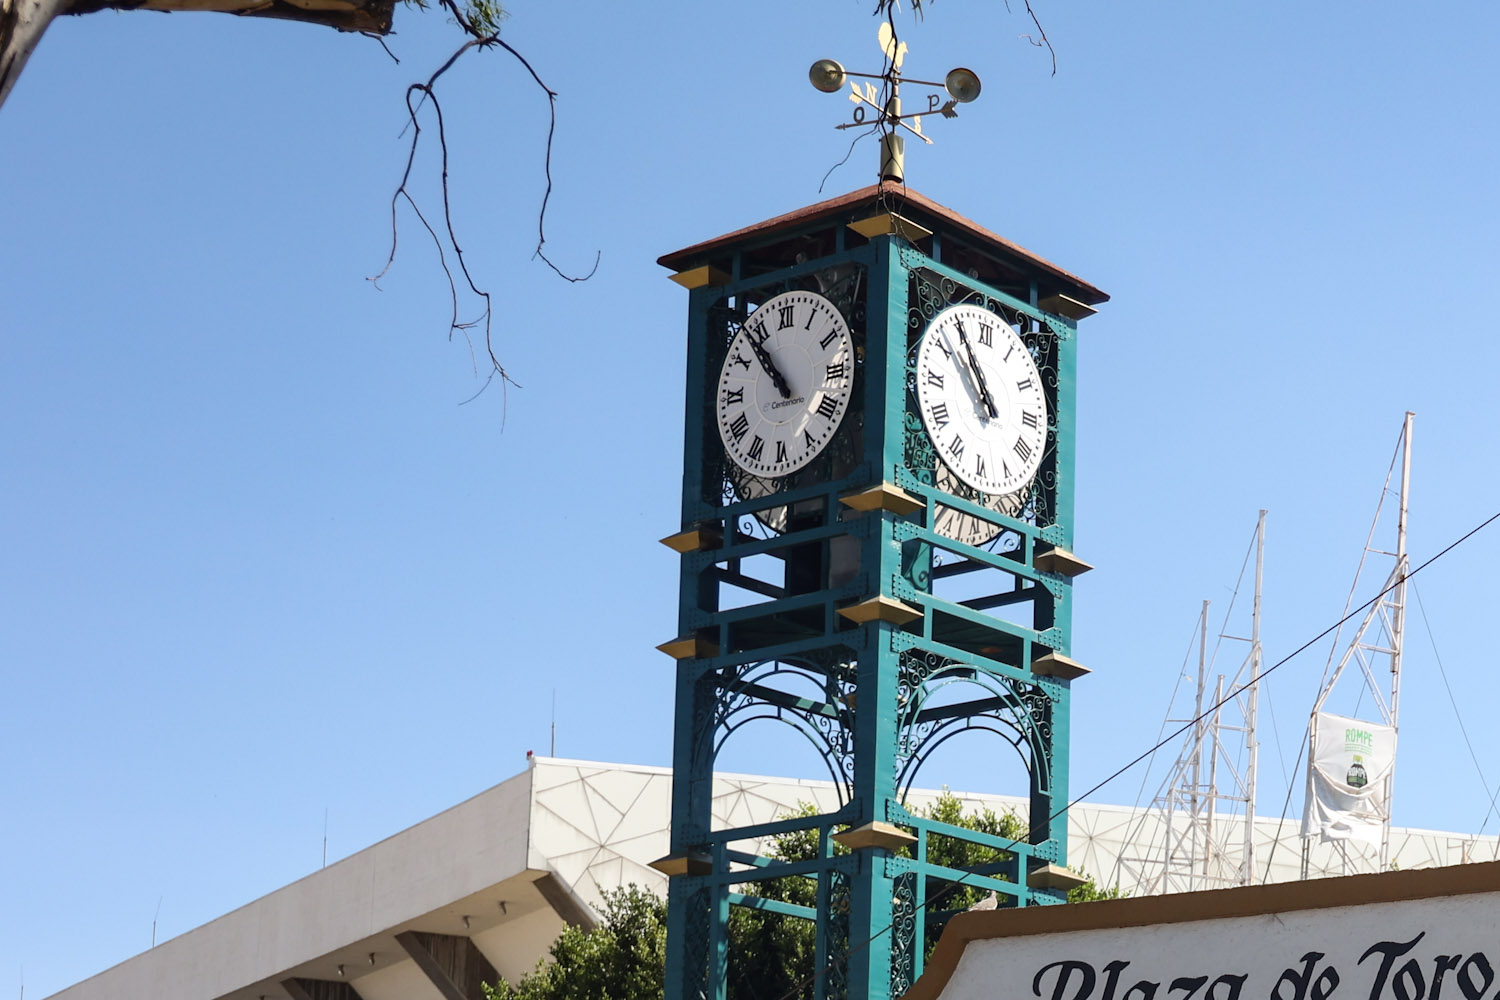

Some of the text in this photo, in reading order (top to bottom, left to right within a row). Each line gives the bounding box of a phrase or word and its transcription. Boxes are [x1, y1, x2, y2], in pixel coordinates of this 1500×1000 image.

[777, 305, 795, 331] XII
[804, 308, 818, 331] I
[819, 328, 838, 351] II
[977, 321, 994, 349] XII
[935, 337, 953, 361] X
[1003, 345, 1015, 363] I
[734, 353, 752, 371] X
[826, 361, 844, 381] III
[927, 368, 945, 391] IX
[1016, 378, 1033, 393] II
[727, 386, 744, 406] IX
[816, 393, 838, 420] IIII
[729, 411, 750, 445] VIII
[931, 401, 950, 432] VIII
[1022, 409, 1038, 430] III
[747, 434, 766, 462] VII
[803, 428, 817, 449] V
[949, 432, 965, 462] VII
[1013, 434, 1033, 464] IIII
[775, 440, 788, 464] VI
[976, 453, 988, 479] VI
[1002, 457, 1012, 479] V
[1345, 728, 1373, 747] ROMPE
